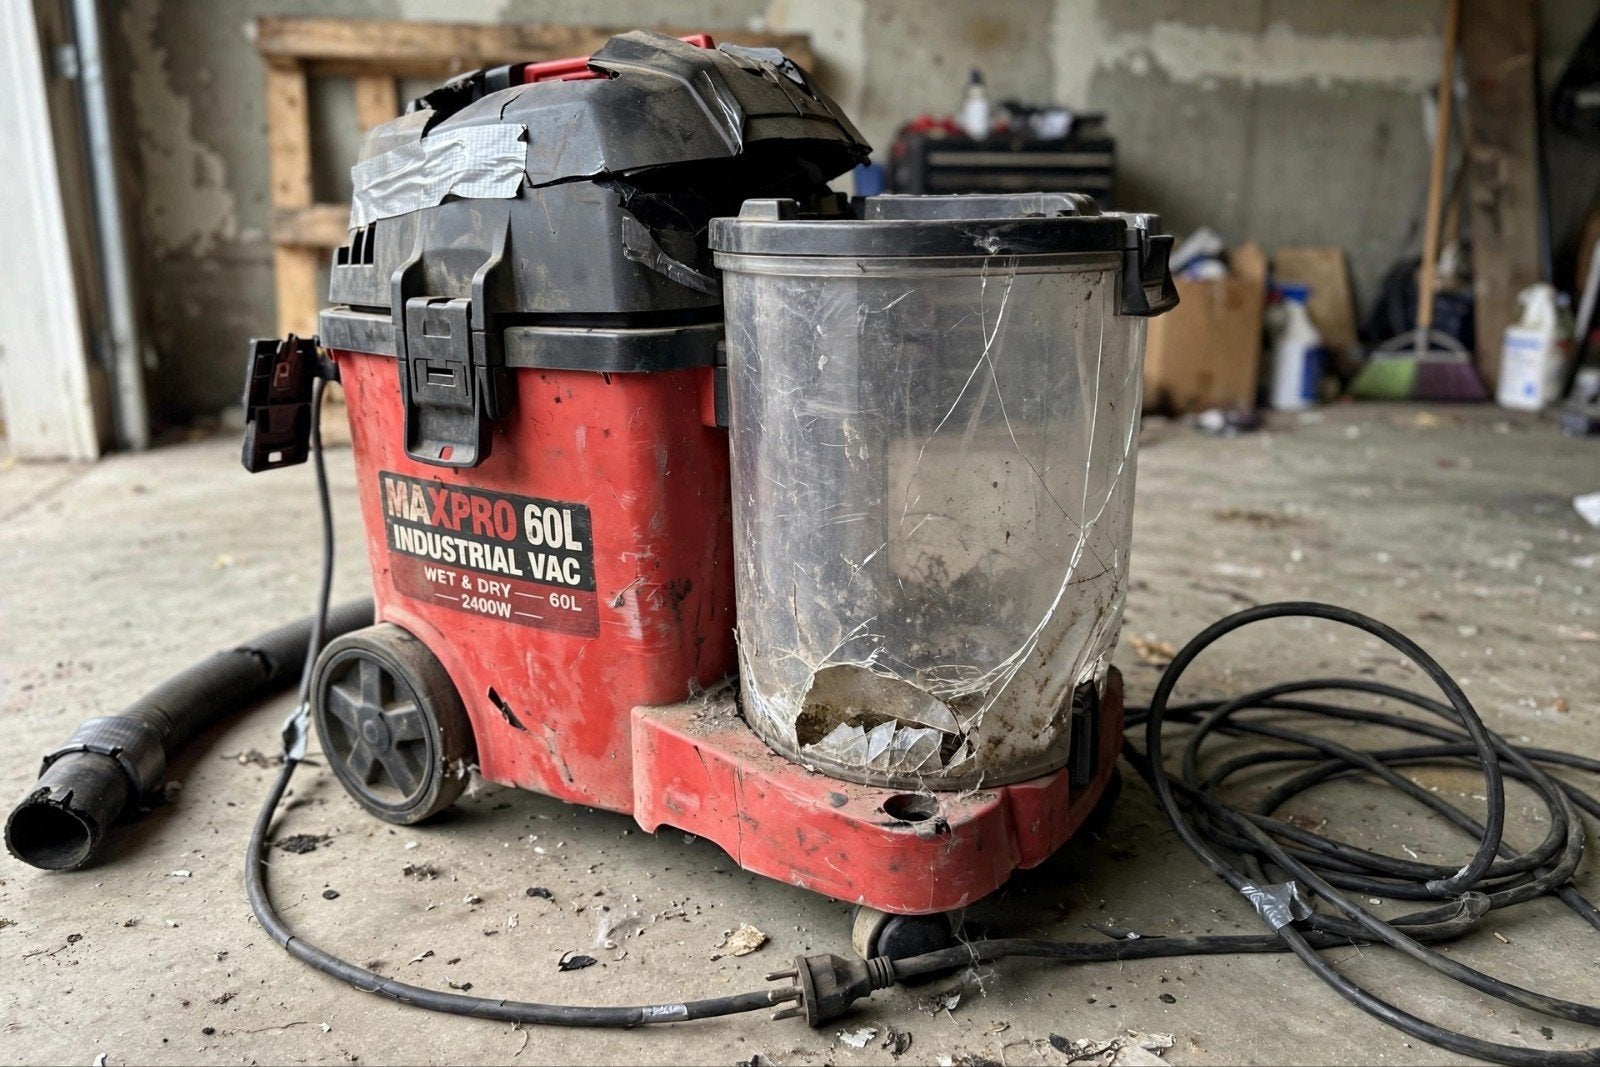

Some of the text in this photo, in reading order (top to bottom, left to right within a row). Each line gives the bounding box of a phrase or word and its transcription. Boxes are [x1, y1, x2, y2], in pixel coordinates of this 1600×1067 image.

[384, 477, 583, 552] MAXPRO 60L
[393, 524, 581, 586] INDUSTRIAL VAC
[424, 565, 582, 612] WET & DRY 60L
[461, 593, 511, 618] 2400W
